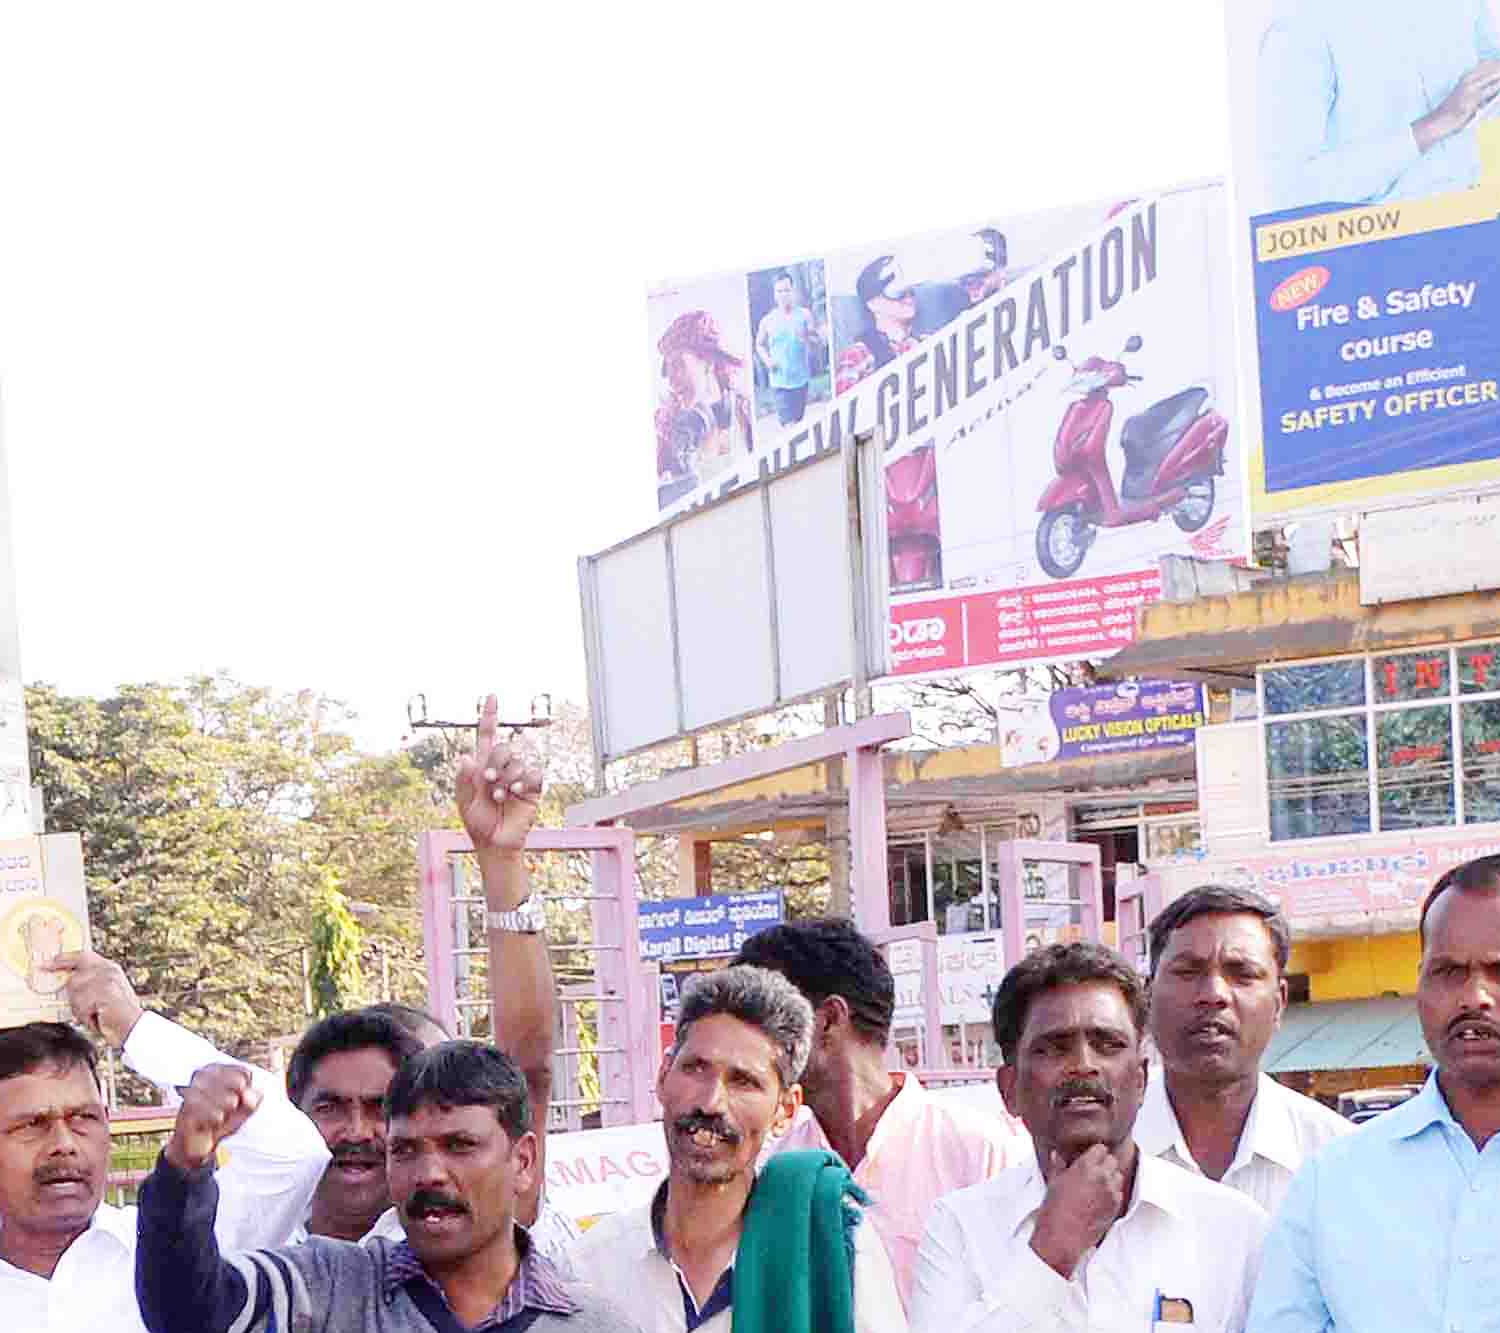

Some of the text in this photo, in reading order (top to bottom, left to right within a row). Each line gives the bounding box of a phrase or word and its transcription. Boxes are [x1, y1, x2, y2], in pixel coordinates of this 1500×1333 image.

[1266, 209, 1401, 254] JOIN NOW
[876, 200, 1158, 452] GENERATION
[1296, 281, 1477, 331] Fire & Safety
[1340, 328, 1434, 362] course
[1280, 380, 1499, 434] SAFETY OFFICER
[1063, 726, 1101, 744] LUCKY
[684, 932, 731, 957] Digital
